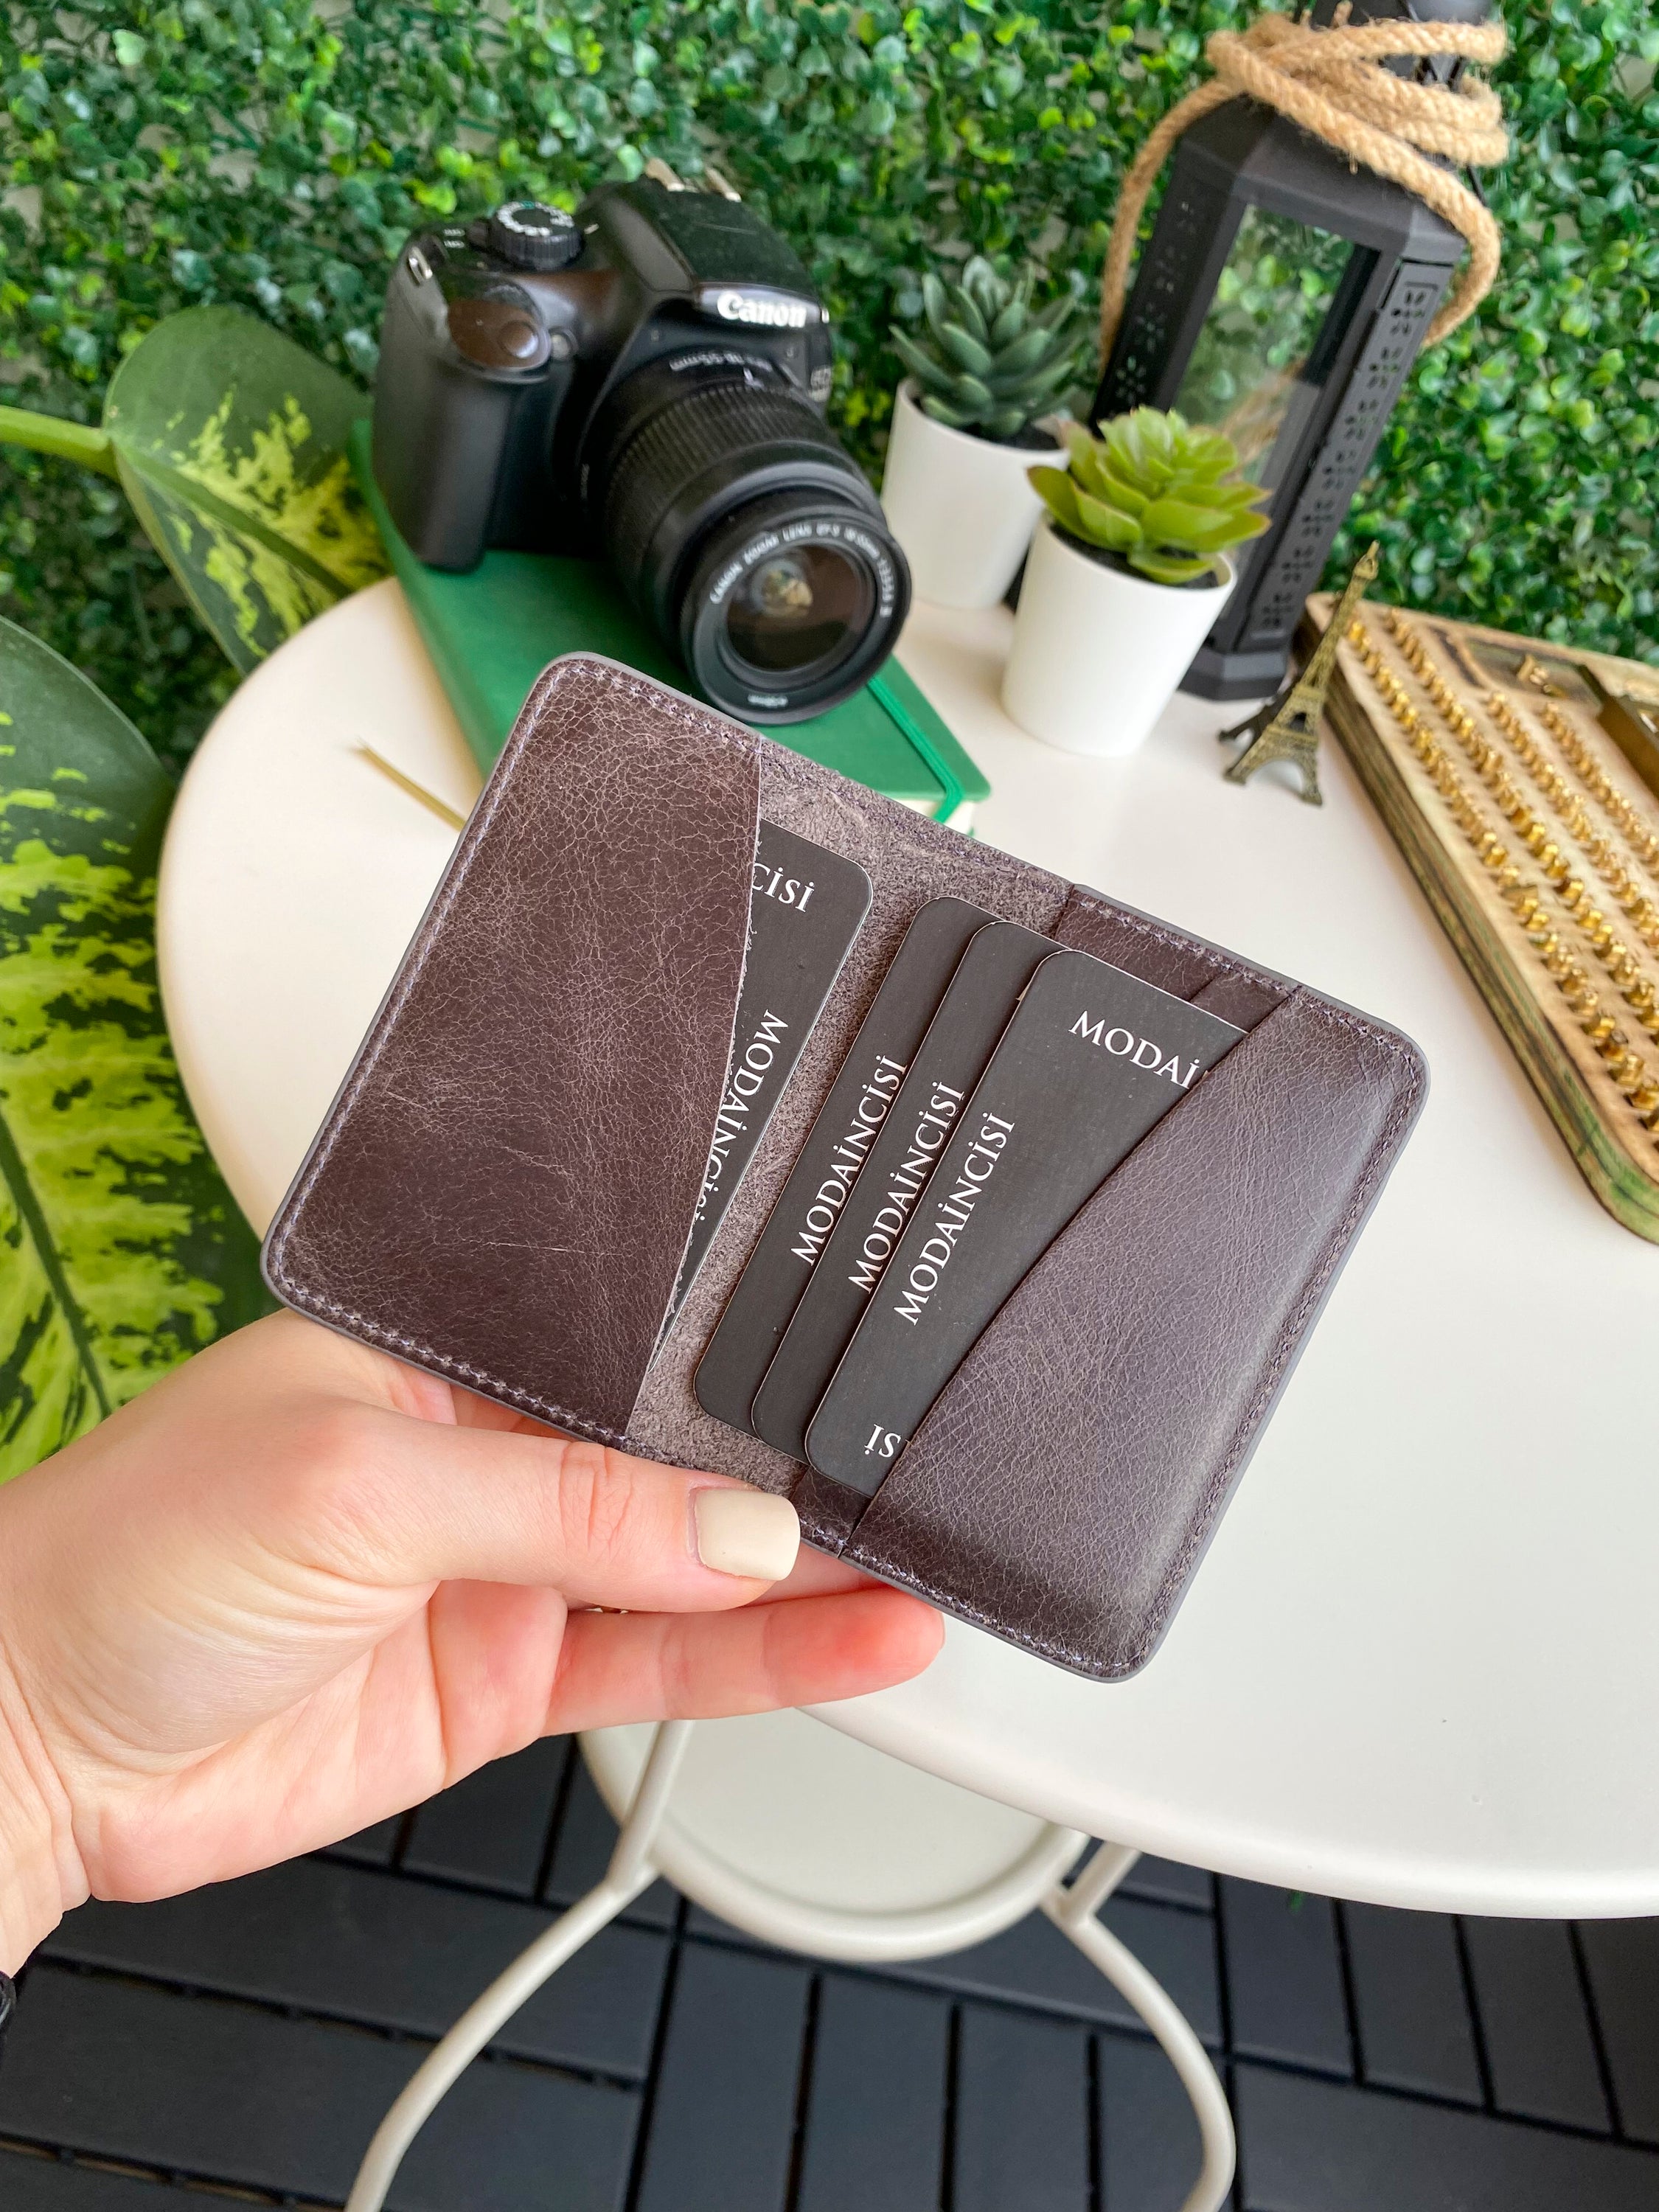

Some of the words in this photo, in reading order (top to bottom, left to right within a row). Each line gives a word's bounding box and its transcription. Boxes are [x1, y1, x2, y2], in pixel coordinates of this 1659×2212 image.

[717, 290, 807, 329] Canon
[1068, 1010, 1208, 1090] MODAİ
[790, 1054, 908, 1266] MODAİNCİSİ
[847, 1081, 964, 1294] MODAİNCİSİ
[893, 1111, 1015, 1326] MODAİNCİSİ
[863, 1424, 914, 1458] Sİ
